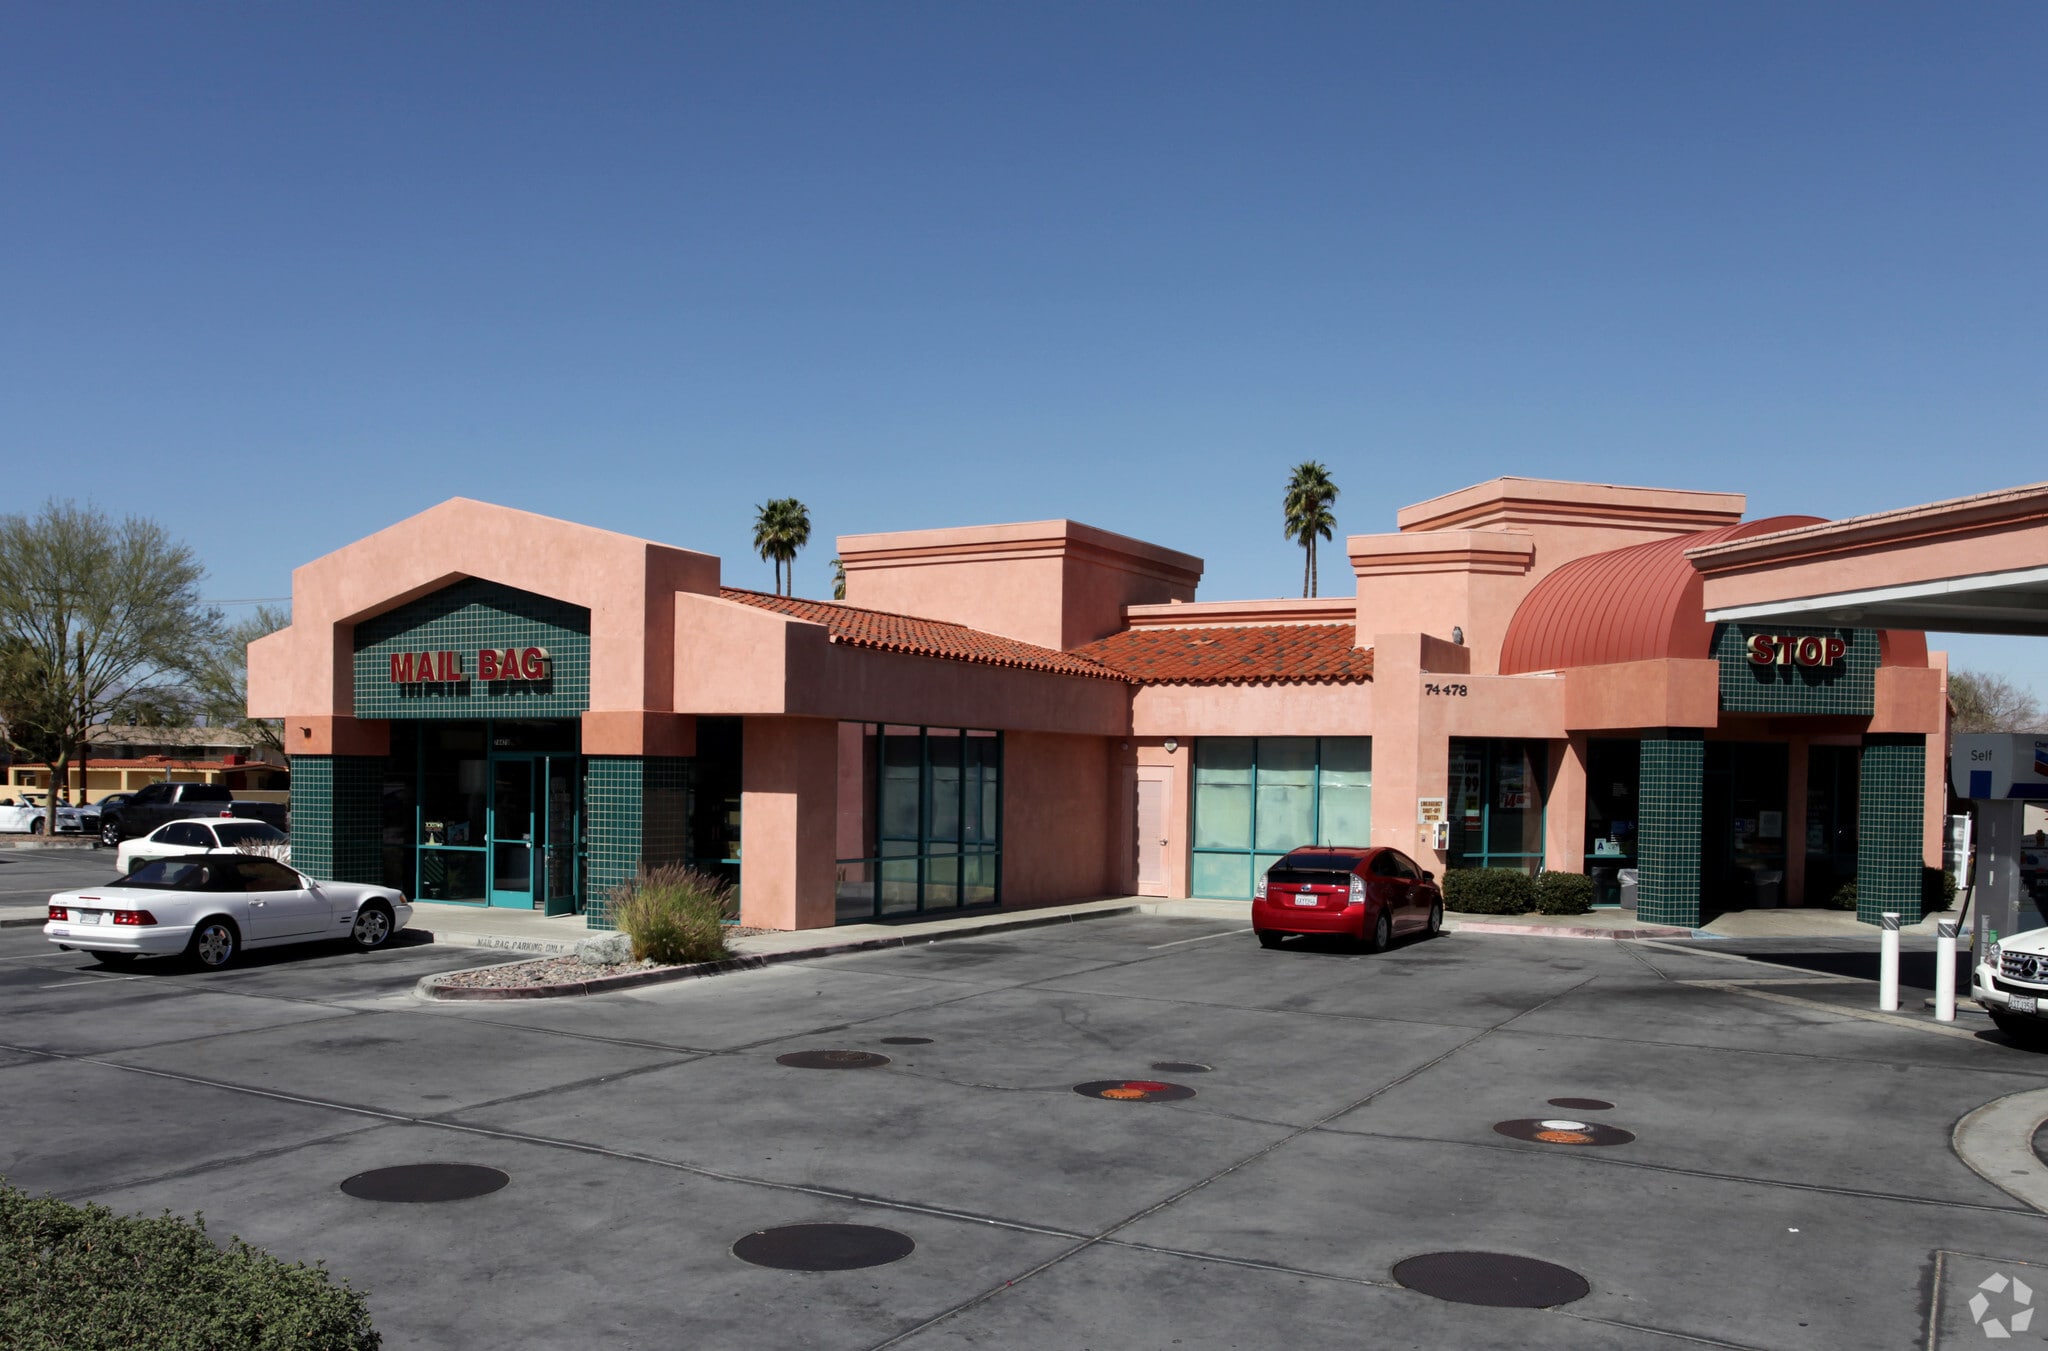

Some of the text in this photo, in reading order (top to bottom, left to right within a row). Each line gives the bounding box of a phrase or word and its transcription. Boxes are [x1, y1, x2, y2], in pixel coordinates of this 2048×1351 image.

[1747, 633, 1846, 666] STOP
[390, 647, 551, 683] MAIL BAG
[1971, 749, 1992, 761] Self
[494, 940, 510, 950] BAG
[511, 941, 543, 952] PARKING
[545, 943, 565, 954] ONLY
